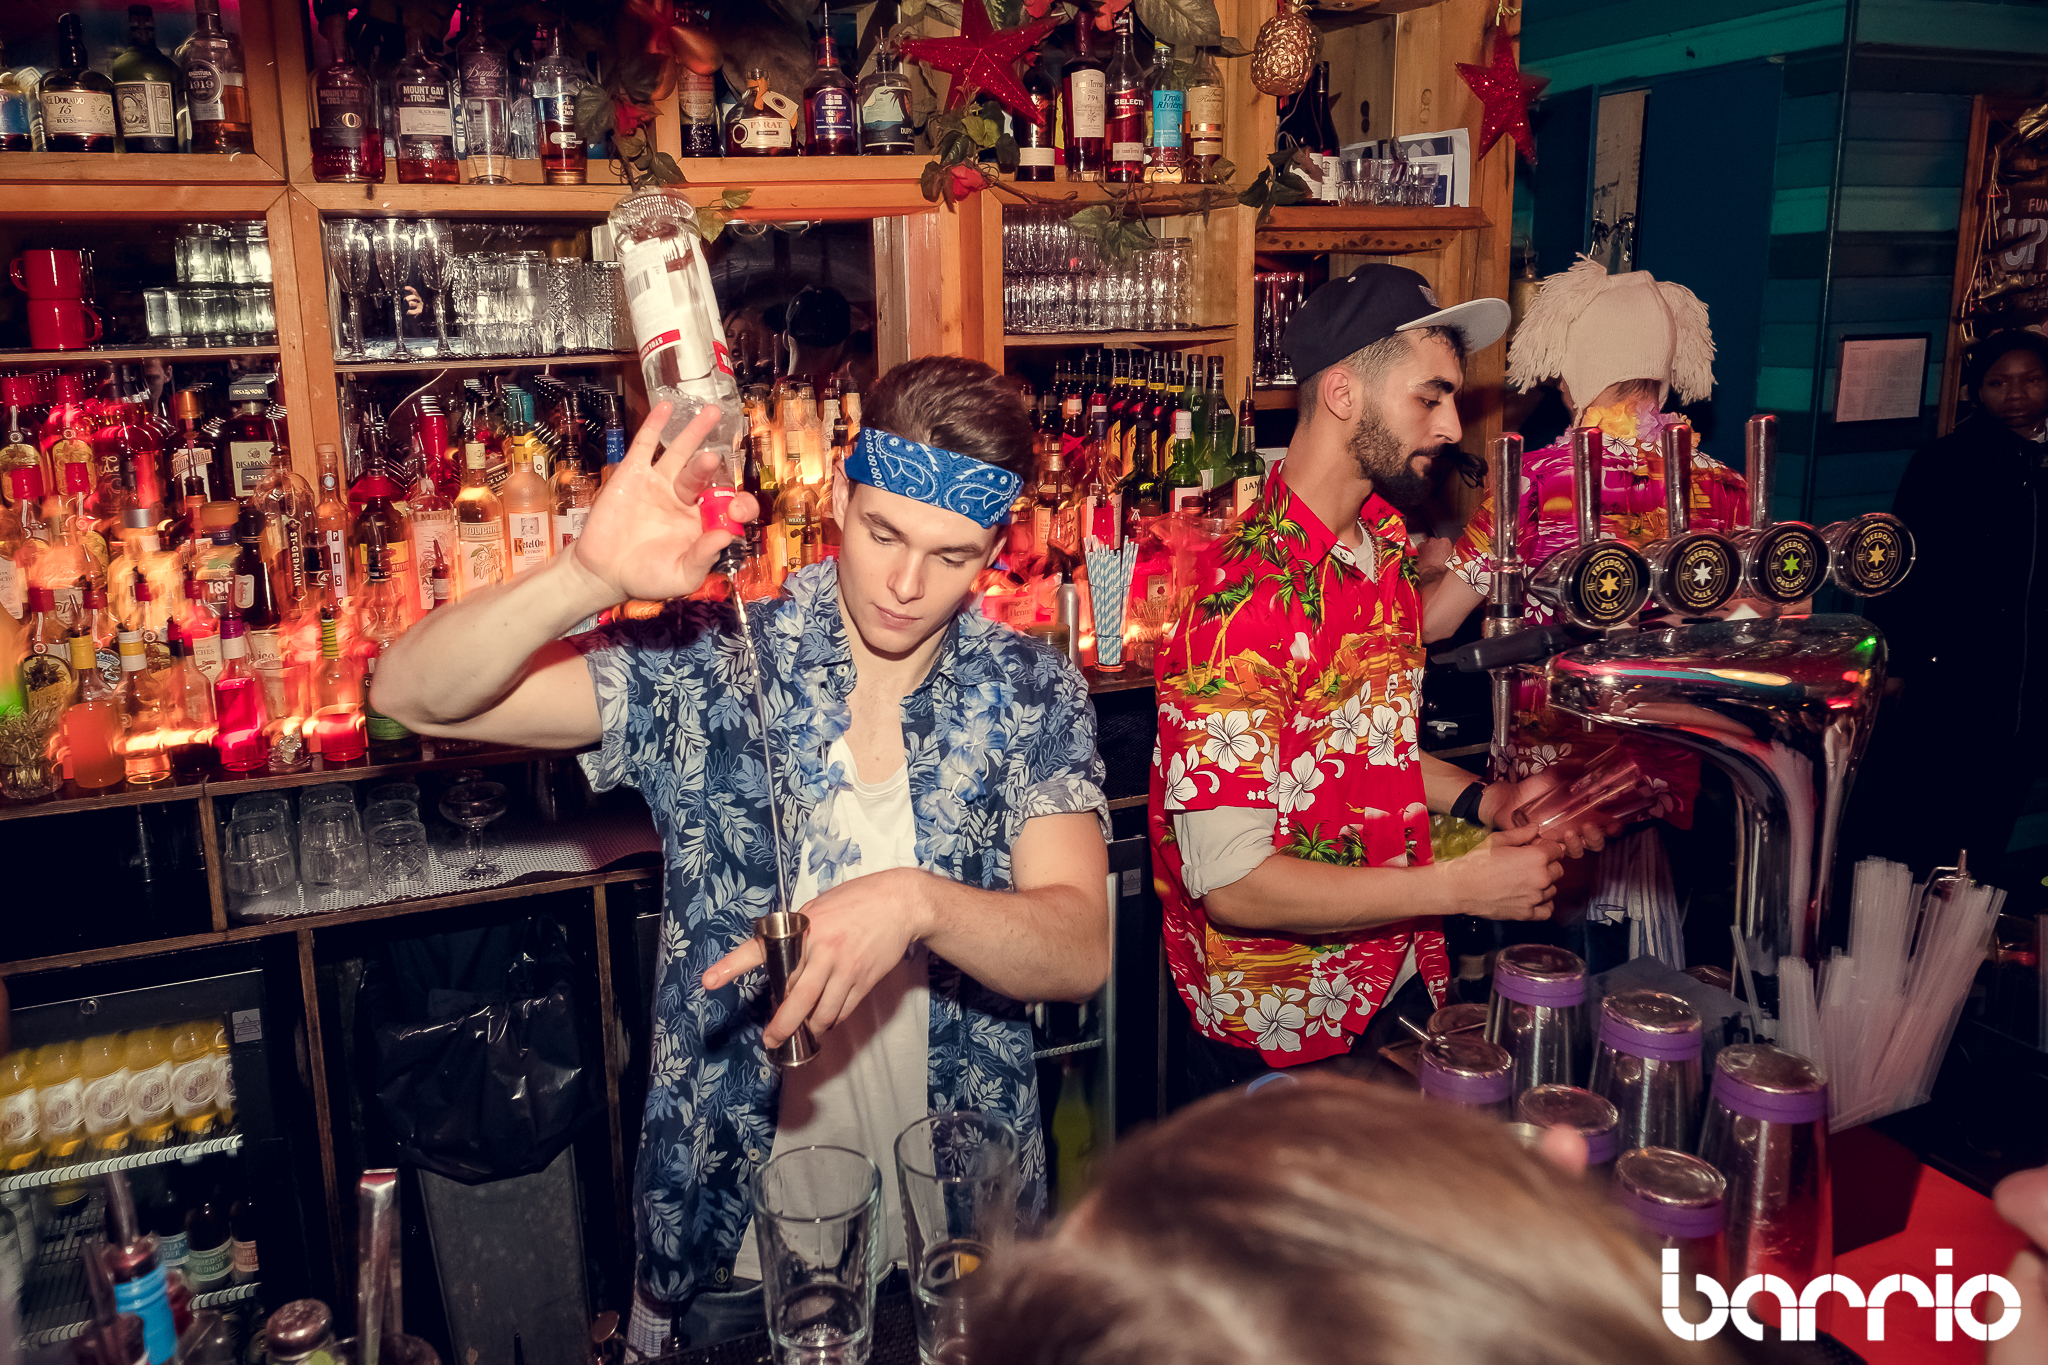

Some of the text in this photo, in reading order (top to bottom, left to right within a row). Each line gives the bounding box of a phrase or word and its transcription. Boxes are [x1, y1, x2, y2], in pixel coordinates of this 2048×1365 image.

[464, 64, 501, 79] Banks
[190, 80, 214, 90] 1919
[320, 89, 359, 98] MOUNT GAY
[403, 85, 444, 96] MOUNT GAY
[326, 97, 340, 105] 1703
[1163, 93, 1181, 102] Trois
[58, 105, 73, 114] 15
[1862, 532, 1893, 547] FREEDOM
[1776, 541, 1807, 556] FREEDOM
[290, 531, 302, 587] ST-GERMAIN
[1686, 549, 1719, 566] FREEDOM
[1591, 559, 1626, 576] FREEDOM
[1868, 570, 1884, 579] PILS
[1775, 574, 1806, 588] ORGANIC
[1693, 588, 1712, 598] PALE
[1600, 601, 1619, 610] PILS
